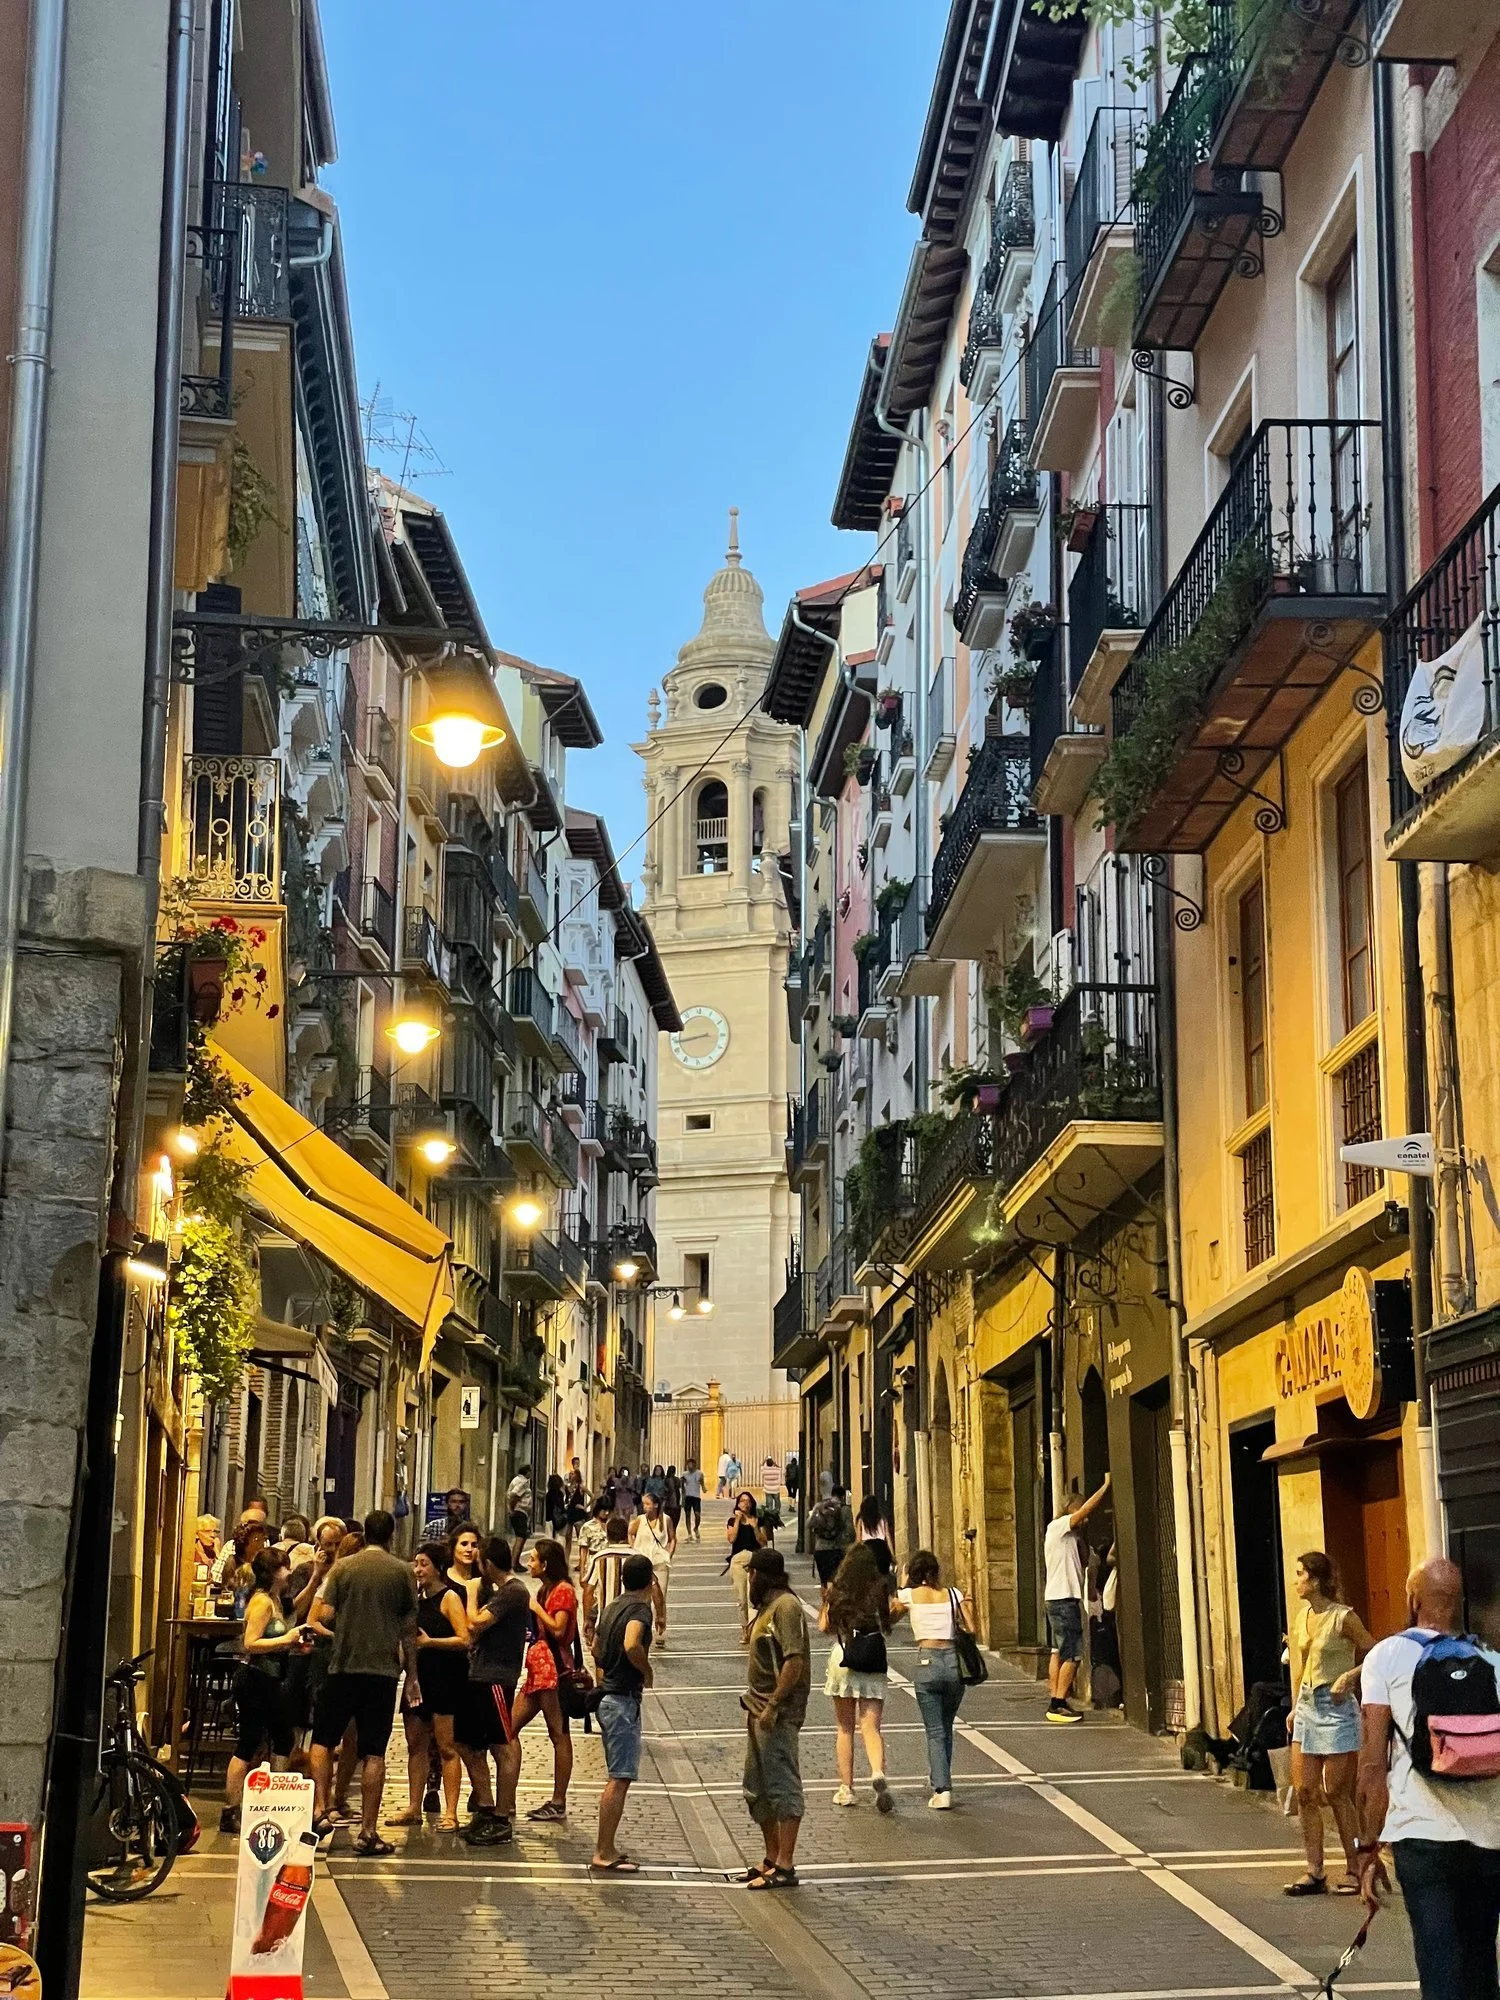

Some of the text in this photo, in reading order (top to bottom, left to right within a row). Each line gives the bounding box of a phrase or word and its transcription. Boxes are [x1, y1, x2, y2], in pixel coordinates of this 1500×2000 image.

[272, 1775, 299, 1783] COLD
[270, 1783, 311, 1791] DRINKS
[258, 1828, 275, 1849] 86
